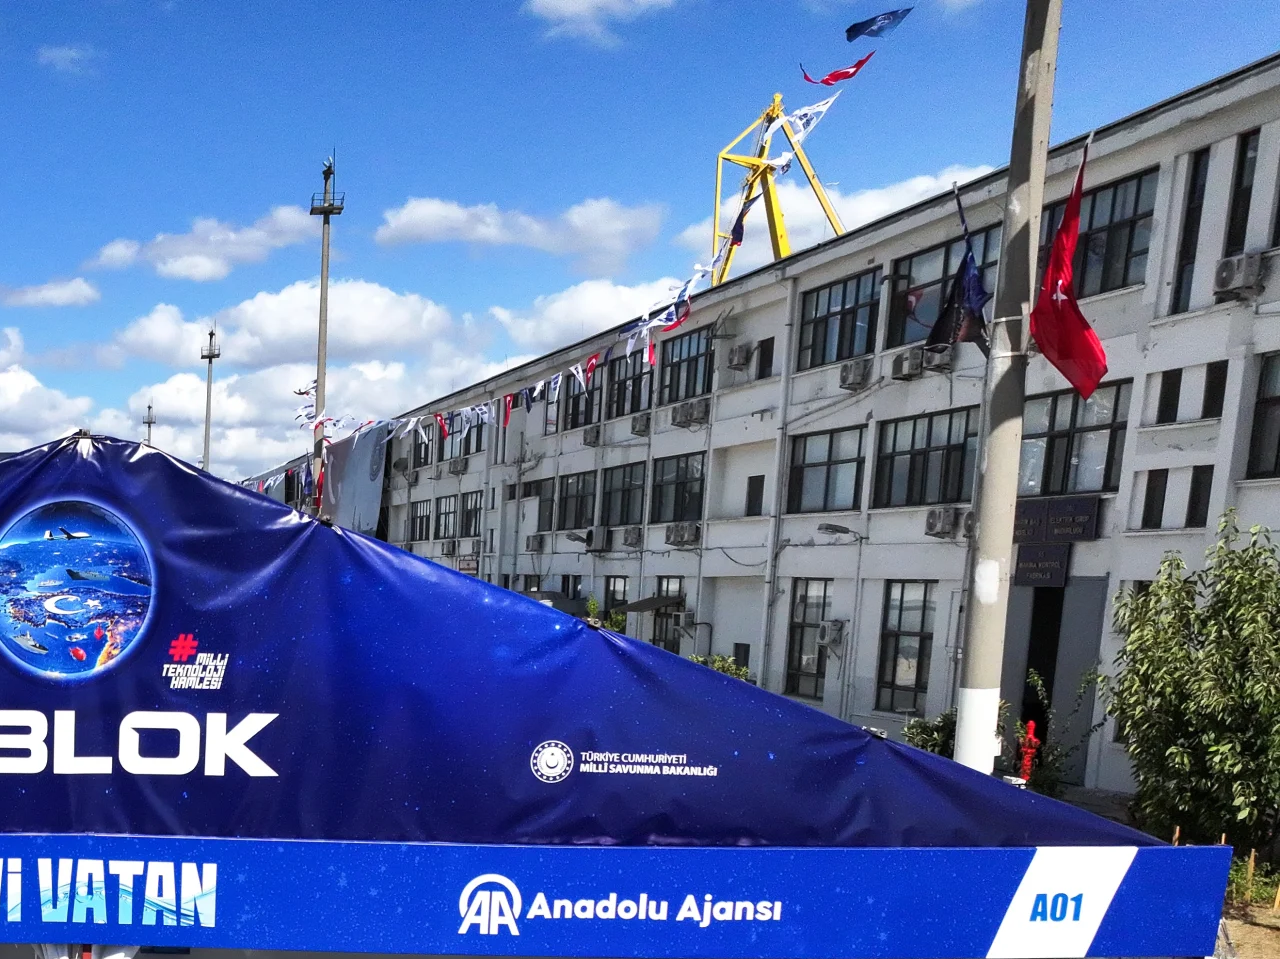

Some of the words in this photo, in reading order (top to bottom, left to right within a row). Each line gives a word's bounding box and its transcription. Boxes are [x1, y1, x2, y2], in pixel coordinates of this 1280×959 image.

[196, 652, 230, 666] MİLLİ
[162, 664, 226, 678] TEKNOLOJİ
[169, 677, 223, 690] HAMLESİ
[580, 751, 620, 762] TÜRKİYE
[621, 752, 687, 765] CUMHURİYETİ
[609, 763, 661, 775] SAVUNMA
[662, 765, 718, 777] BAKANLIĞI
[37, 858, 218, 928] VATAN
[526, 892, 668, 921] Anadolu
[675, 894, 782, 928] Ajansı
[1029, 892, 1084, 922] A01
